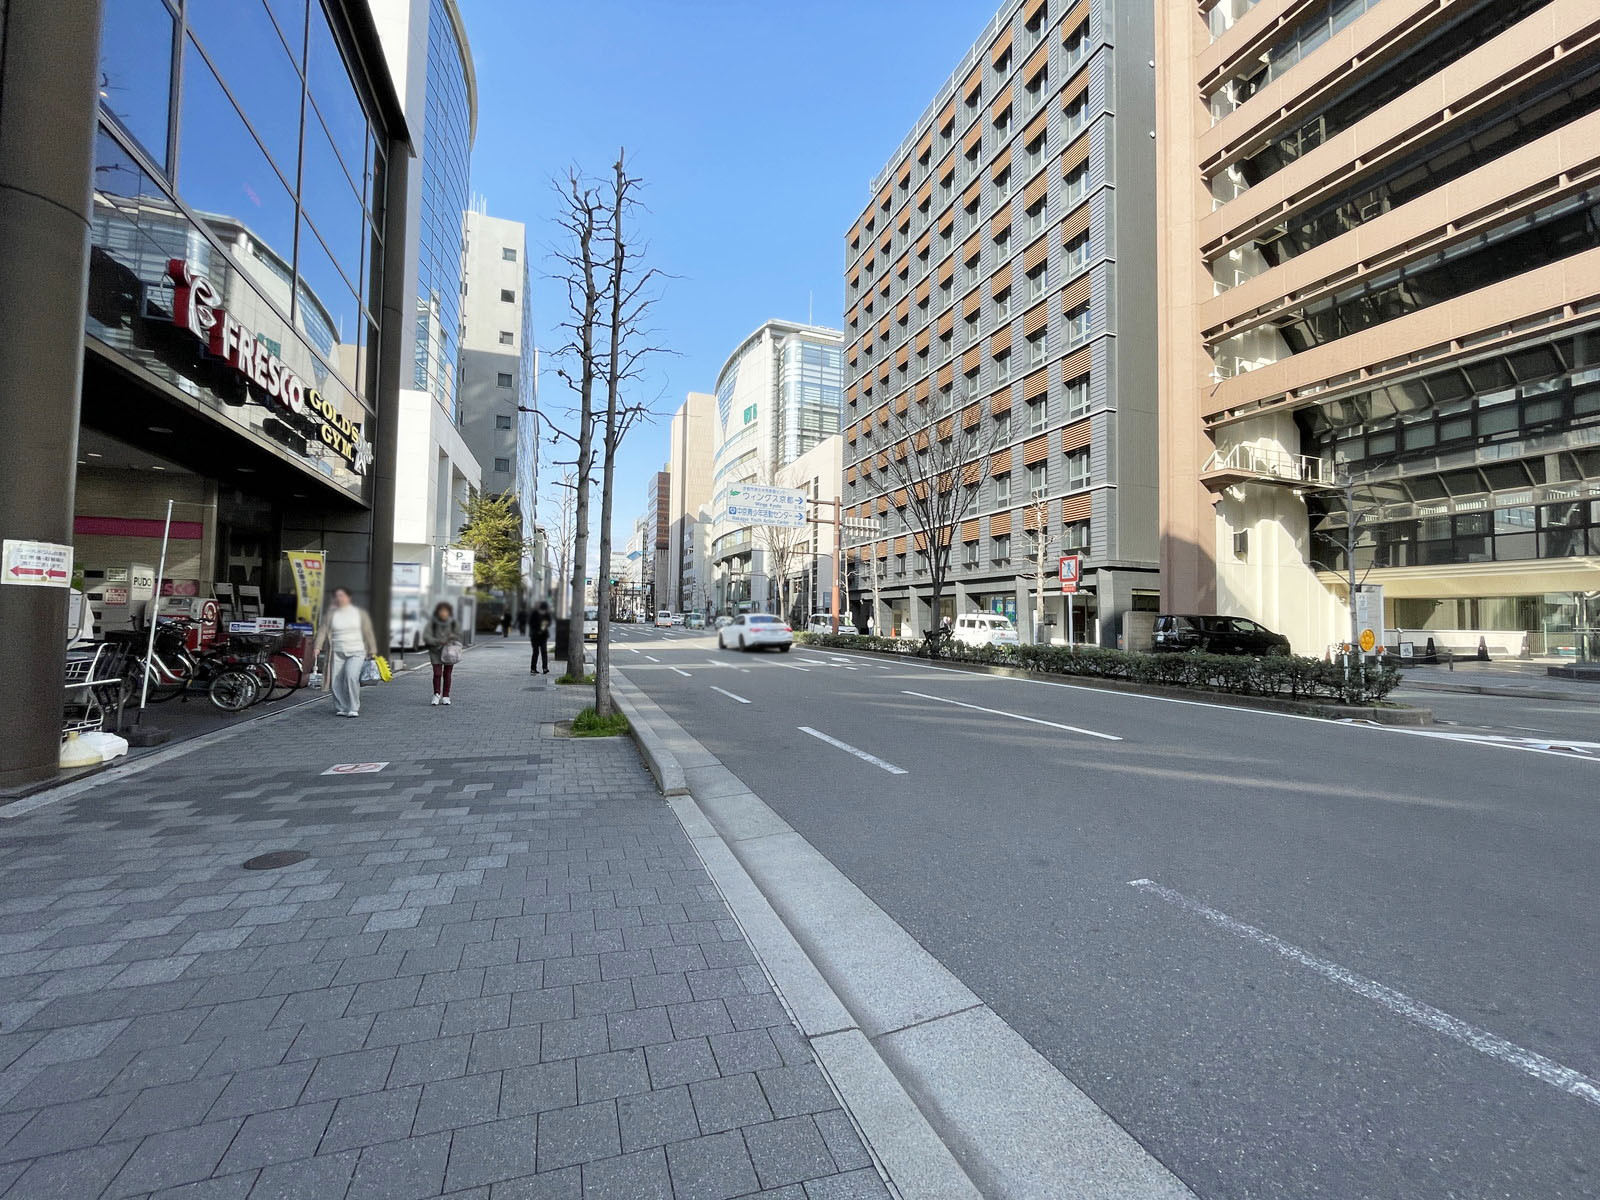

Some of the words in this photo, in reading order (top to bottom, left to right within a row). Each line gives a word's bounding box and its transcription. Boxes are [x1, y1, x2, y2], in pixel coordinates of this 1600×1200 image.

[222, 311, 304, 414] FRESCO
[310, 389, 359, 443] GOLD'S
[742, 492, 794, 504] ウィングス京都
[133, 576, 152, 587] PUDO
